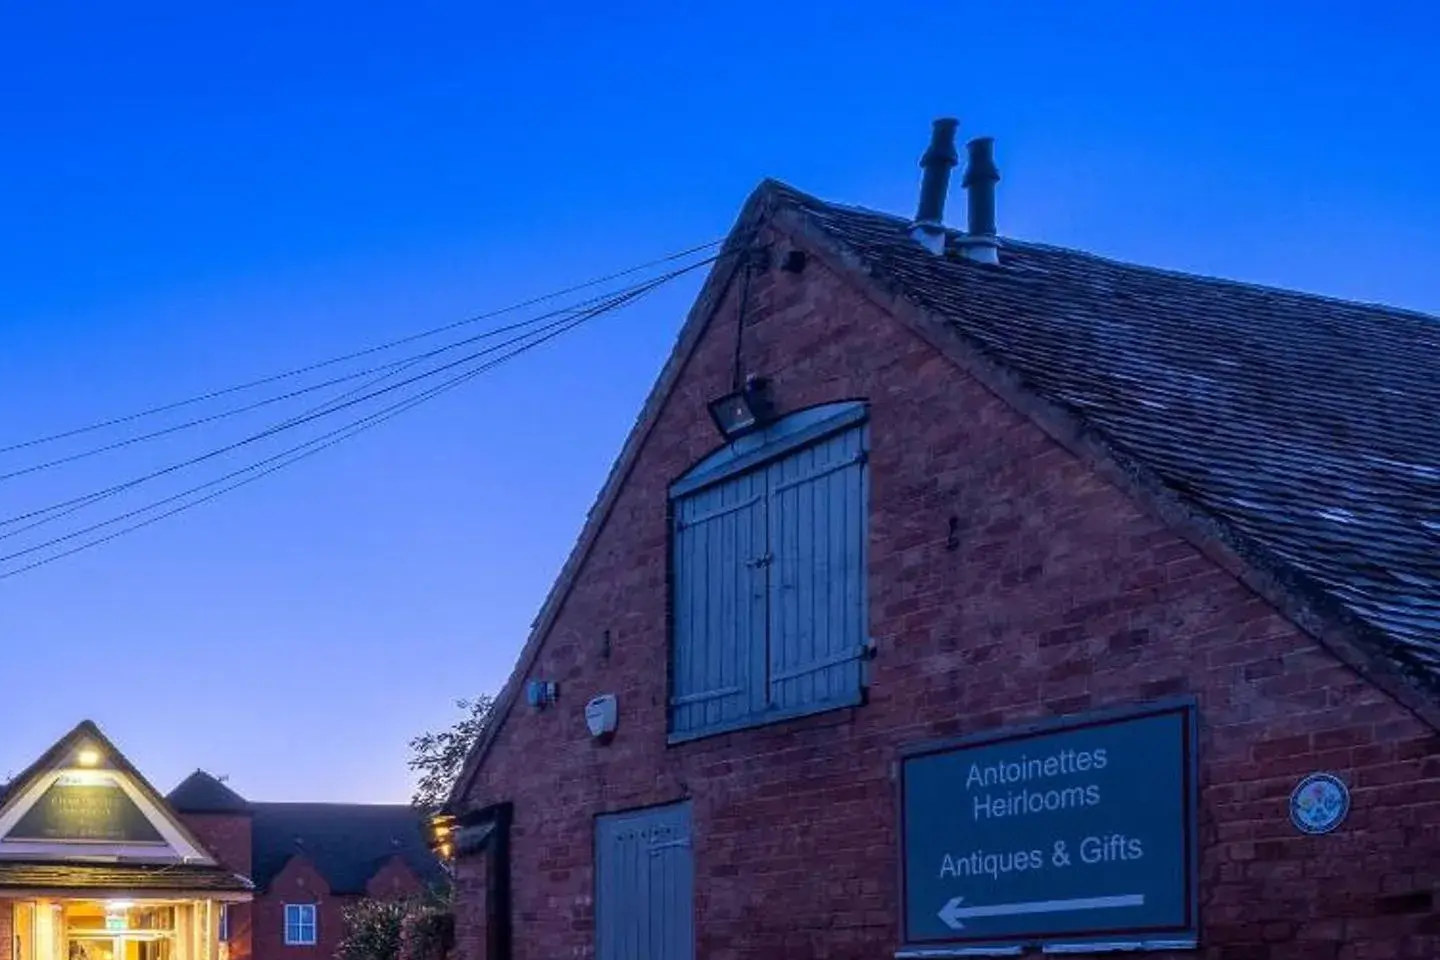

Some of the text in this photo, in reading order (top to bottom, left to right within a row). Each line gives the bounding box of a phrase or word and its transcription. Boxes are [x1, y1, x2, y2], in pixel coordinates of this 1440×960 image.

[966, 748, 1108, 790] Antoinettes
[973, 783, 1101, 820] Heirlooms
[939, 834, 1144, 880] Antiques & Gifts
